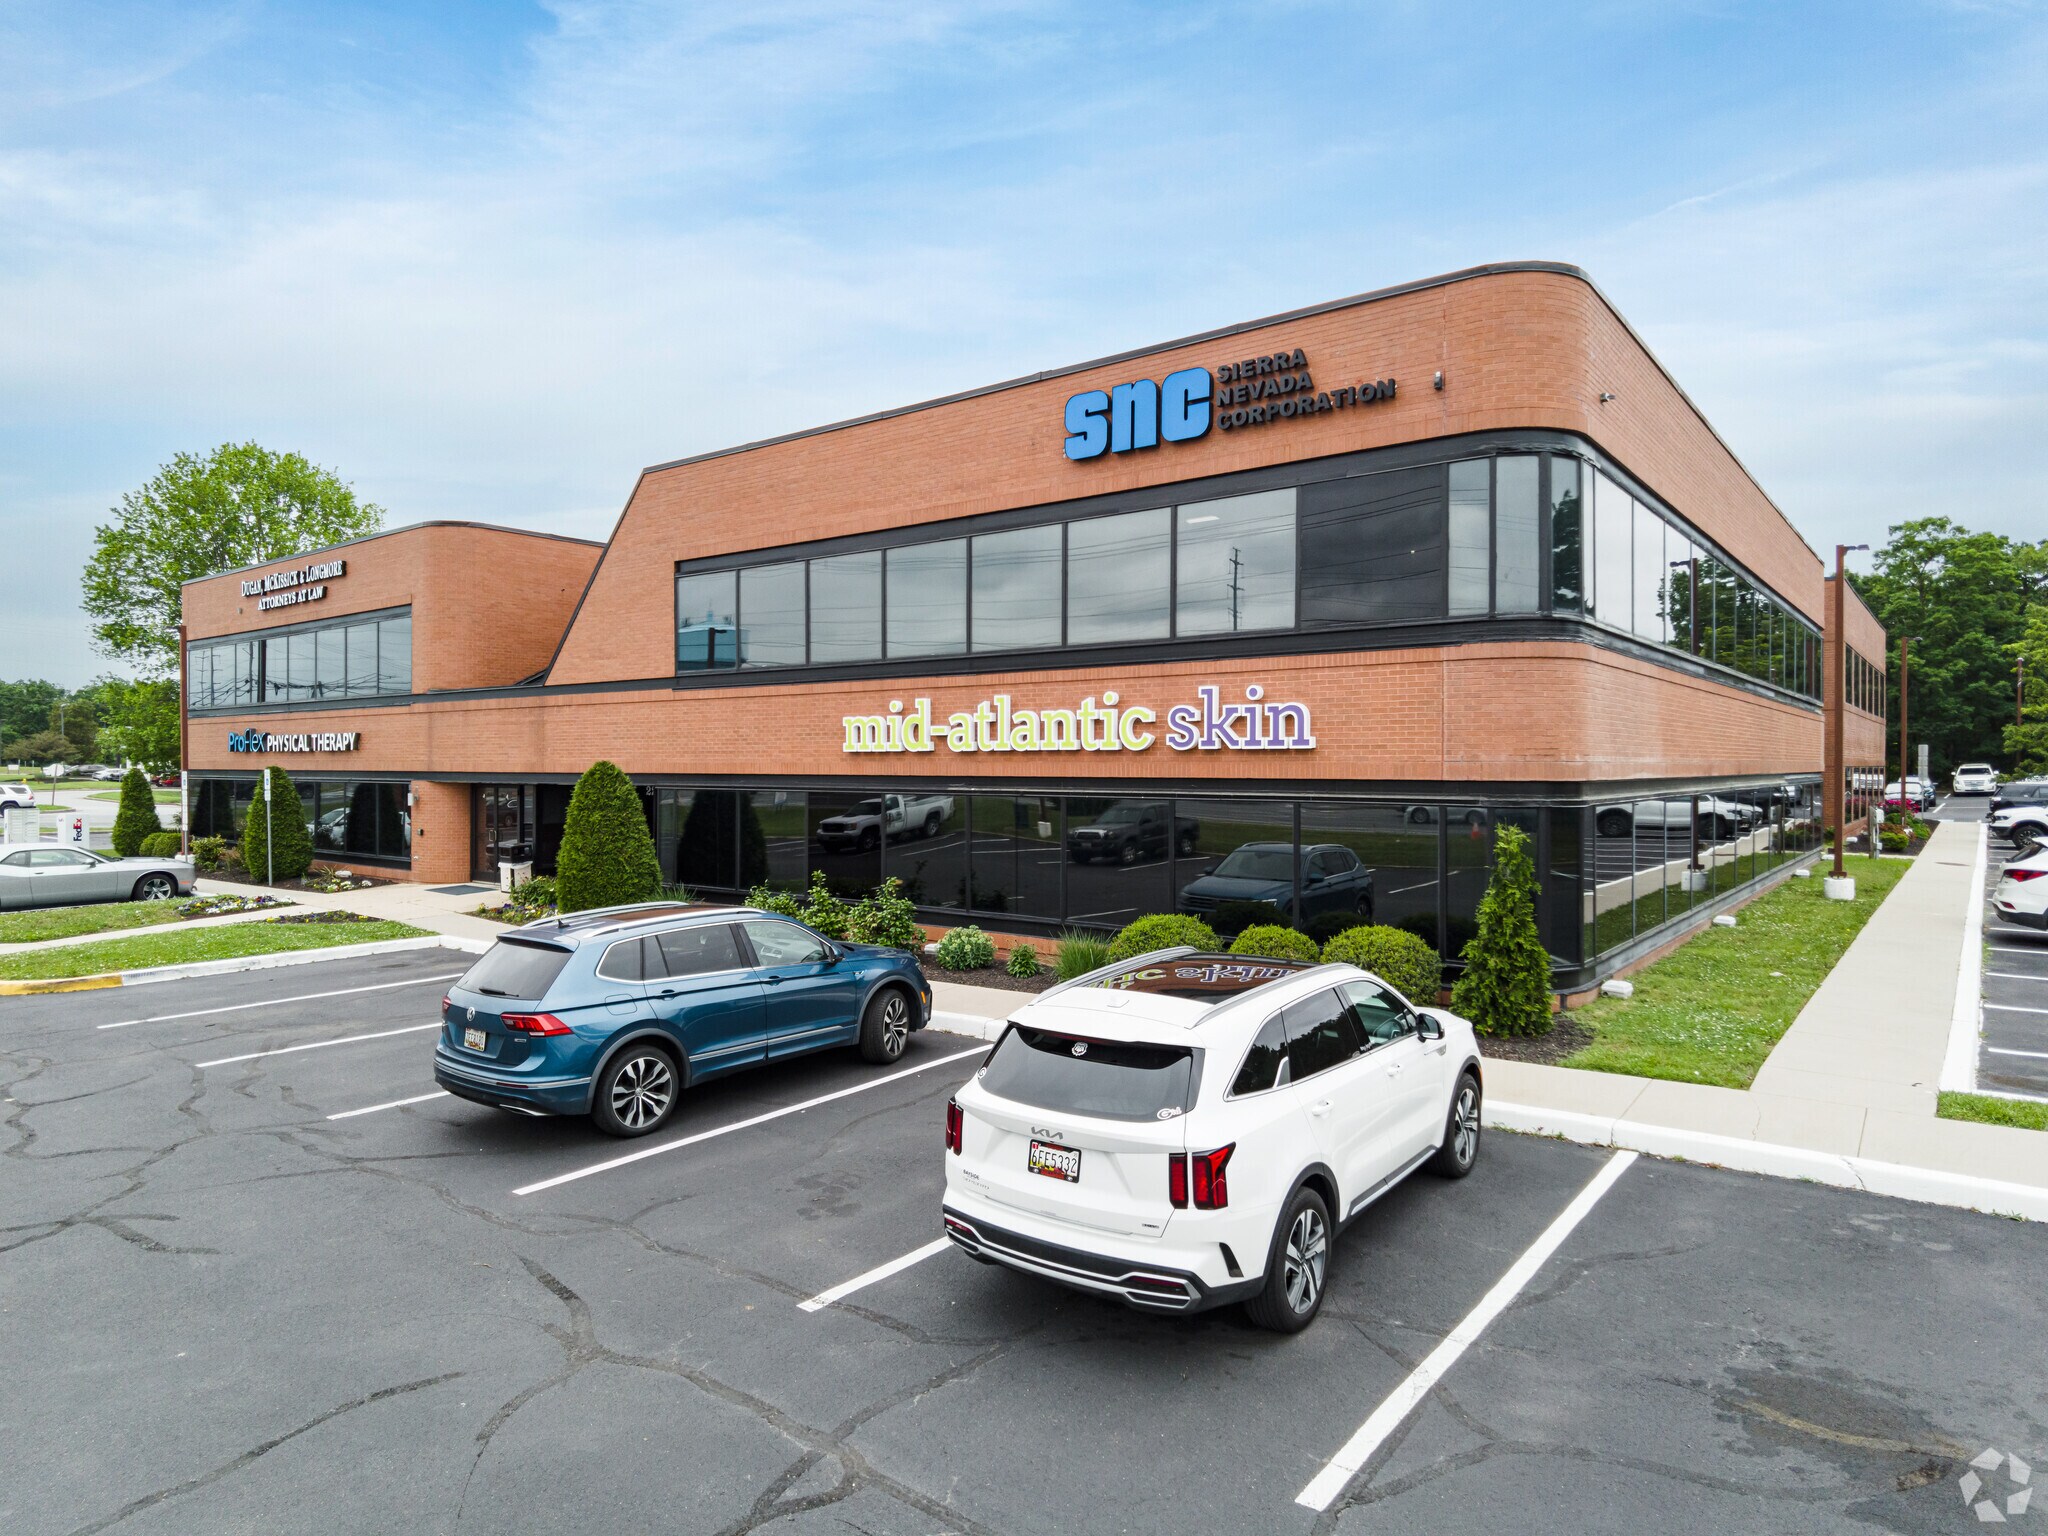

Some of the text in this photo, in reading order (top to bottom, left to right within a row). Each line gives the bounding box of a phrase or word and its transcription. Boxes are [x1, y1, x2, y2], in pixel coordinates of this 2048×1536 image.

[1216, 348, 1308, 384] SIERRA
[1216, 371, 1314, 407] NEVADA
[1216, 378, 1397, 431] CORPORATION
[300, 571, 305, 584] &
[306, 560, 343, 582] LONGMORE
[258, 586, 324, 611] ATTORNEYS AT LAW
[842, 685, 1317, 753] mid-atlantic skin
[266, 734, 309, 752] PHYSICAL
[311, 732, 356, 751] THERAPY
[73, 818, 82, 841] FedEx
